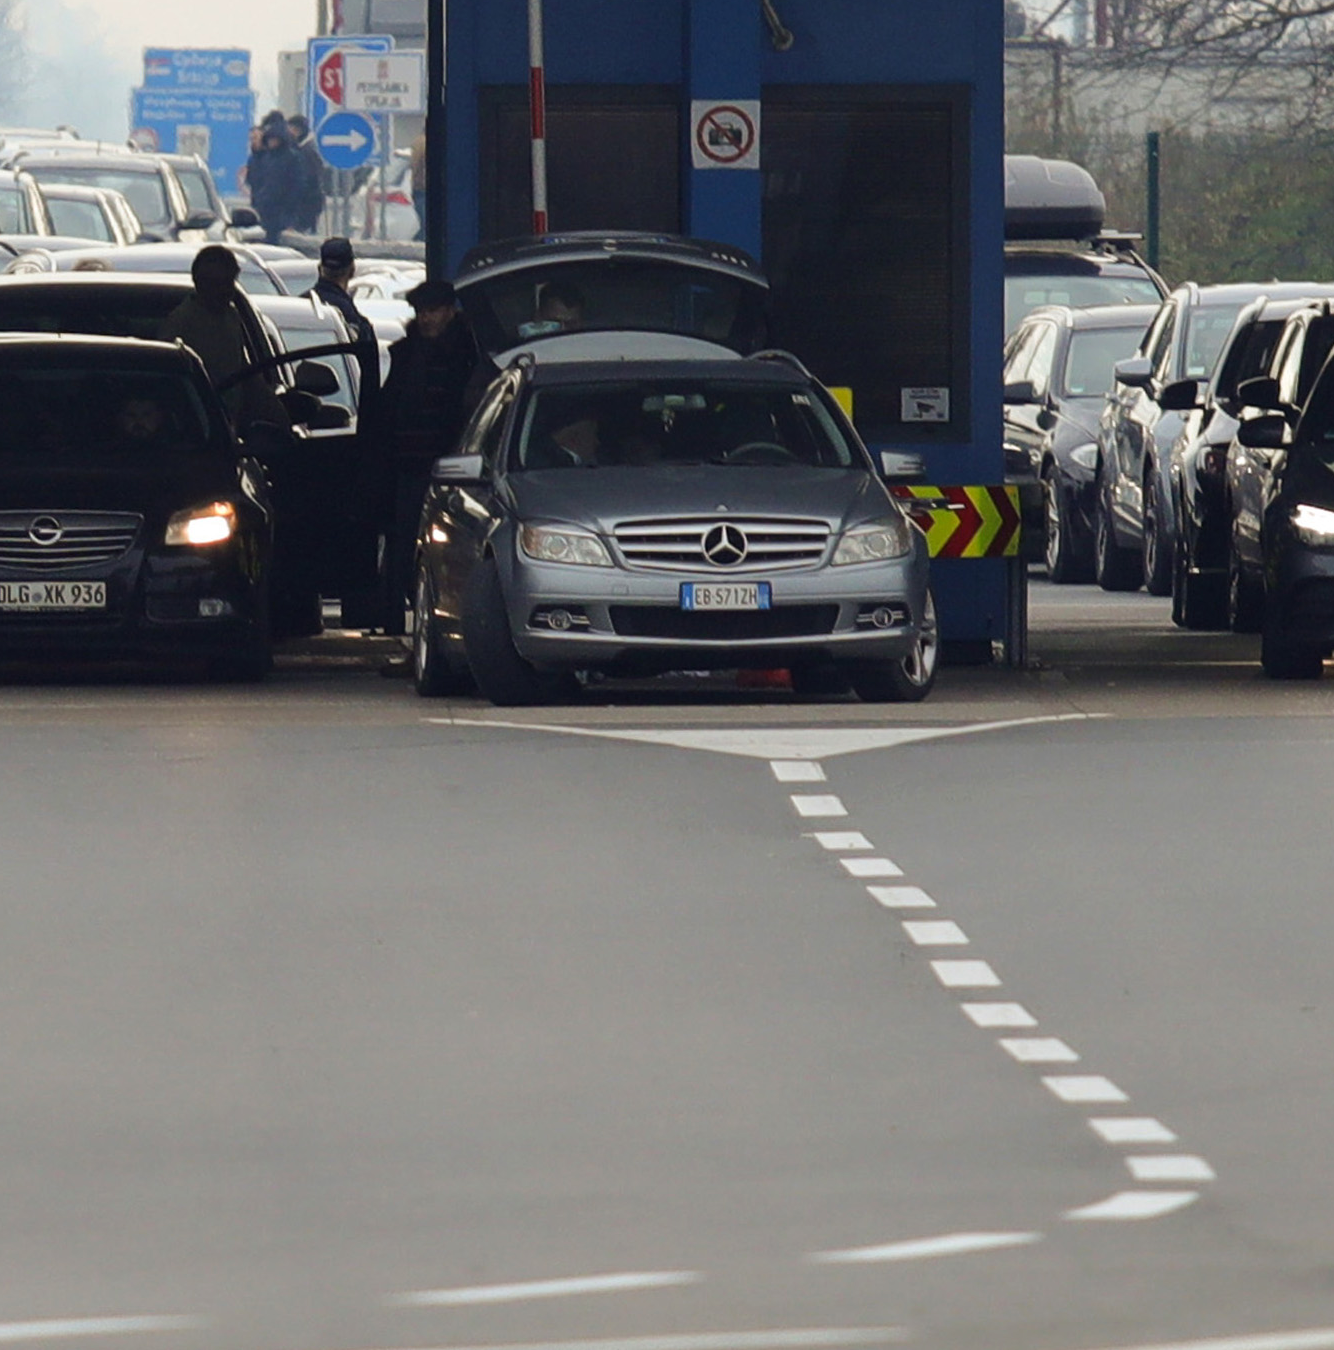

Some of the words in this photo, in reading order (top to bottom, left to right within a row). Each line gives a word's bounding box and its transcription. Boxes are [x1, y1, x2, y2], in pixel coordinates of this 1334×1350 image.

[323, 68, 344, 88] ST
[43, 584, 66, 604] XK
[71, 584, 104, 604] 936
